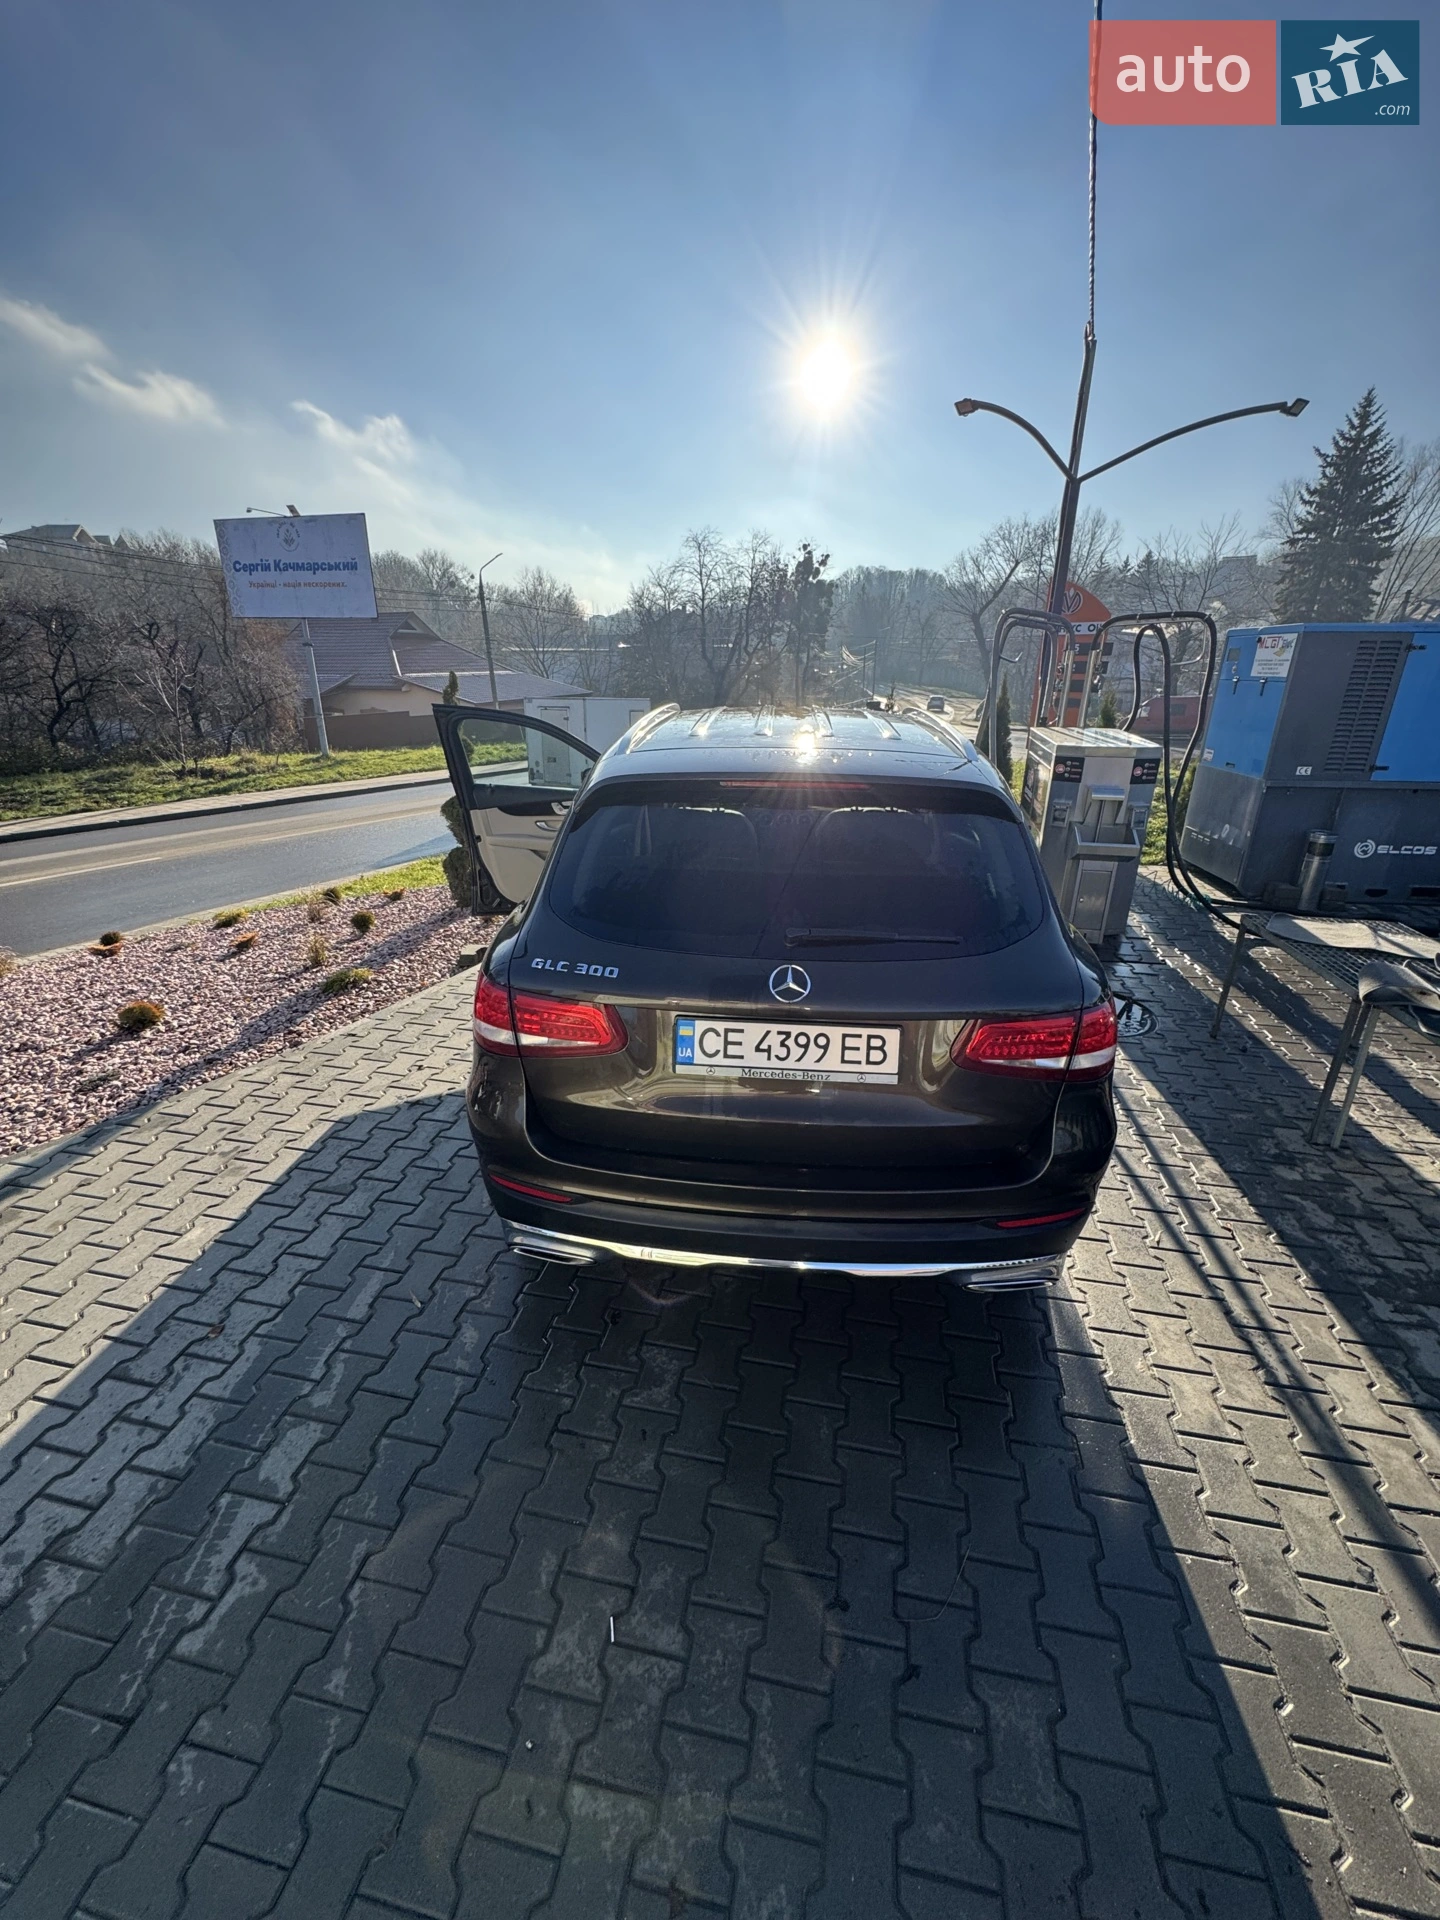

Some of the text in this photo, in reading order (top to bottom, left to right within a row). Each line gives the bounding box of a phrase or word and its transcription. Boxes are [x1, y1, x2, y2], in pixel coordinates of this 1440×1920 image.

[232, 557, 358, 576] Сергій Качмарський
[248, 580, 278, 590] Українці
[283, 580, 302, 590] нація
[1376, 844, 1438, 855] ELCOS
[531, 957, 619, 978] GLC 300
[678, 1047, 693, 1058] UA
[698, 1027, 888, 1066] CE 4399 EB
[741, 1068, 831, 1081] Mercedes-Benz
